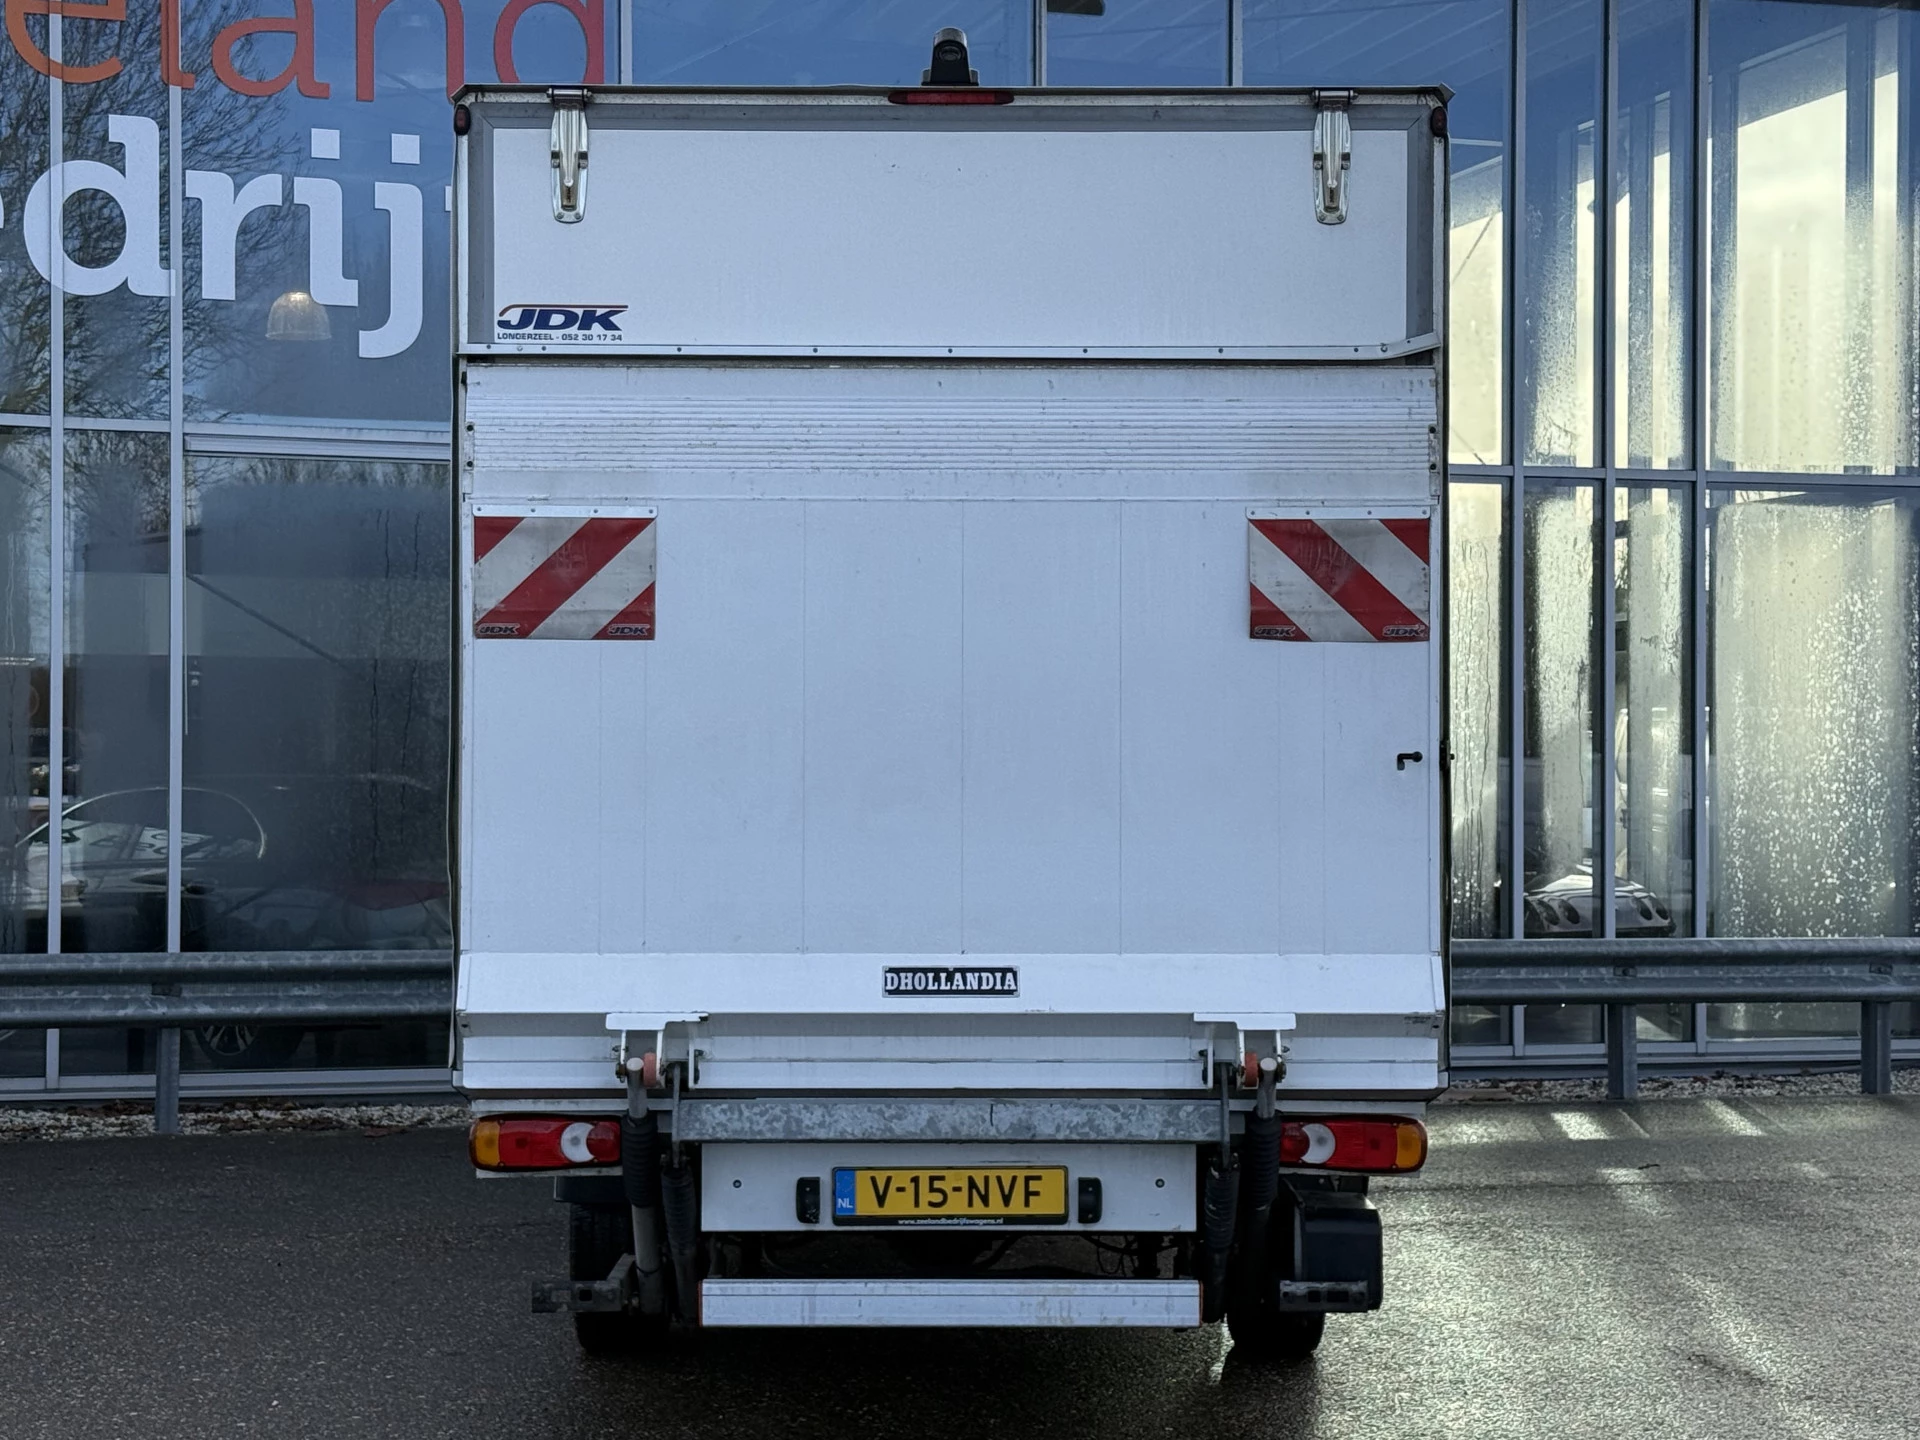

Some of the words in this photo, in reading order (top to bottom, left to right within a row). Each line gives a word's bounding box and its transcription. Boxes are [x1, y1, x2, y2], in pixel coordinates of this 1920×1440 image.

[0, 114, 452, 359] drij
[496, 308, 628, 332] JDK
[496, 332, 555, 341] LONDERZEEL
[561, 333, 580, 342] 052
[581, 333, 594, 342] 30
[596, 334, 608, 342] 17
[610, 334, 623, 342] 34
[479, 625, 518, 635] JDK
[608, 626, 647, 636] JDK
[1254, 627, 1294, 637] JDK
[1383, 626, 1425, 637] JDK
[885, 972, 1017, 991] DHOLLANDIA
[869, 1174, 1043, 1209] V-15-NVF
[837, 1197, 853, 1209] NL
